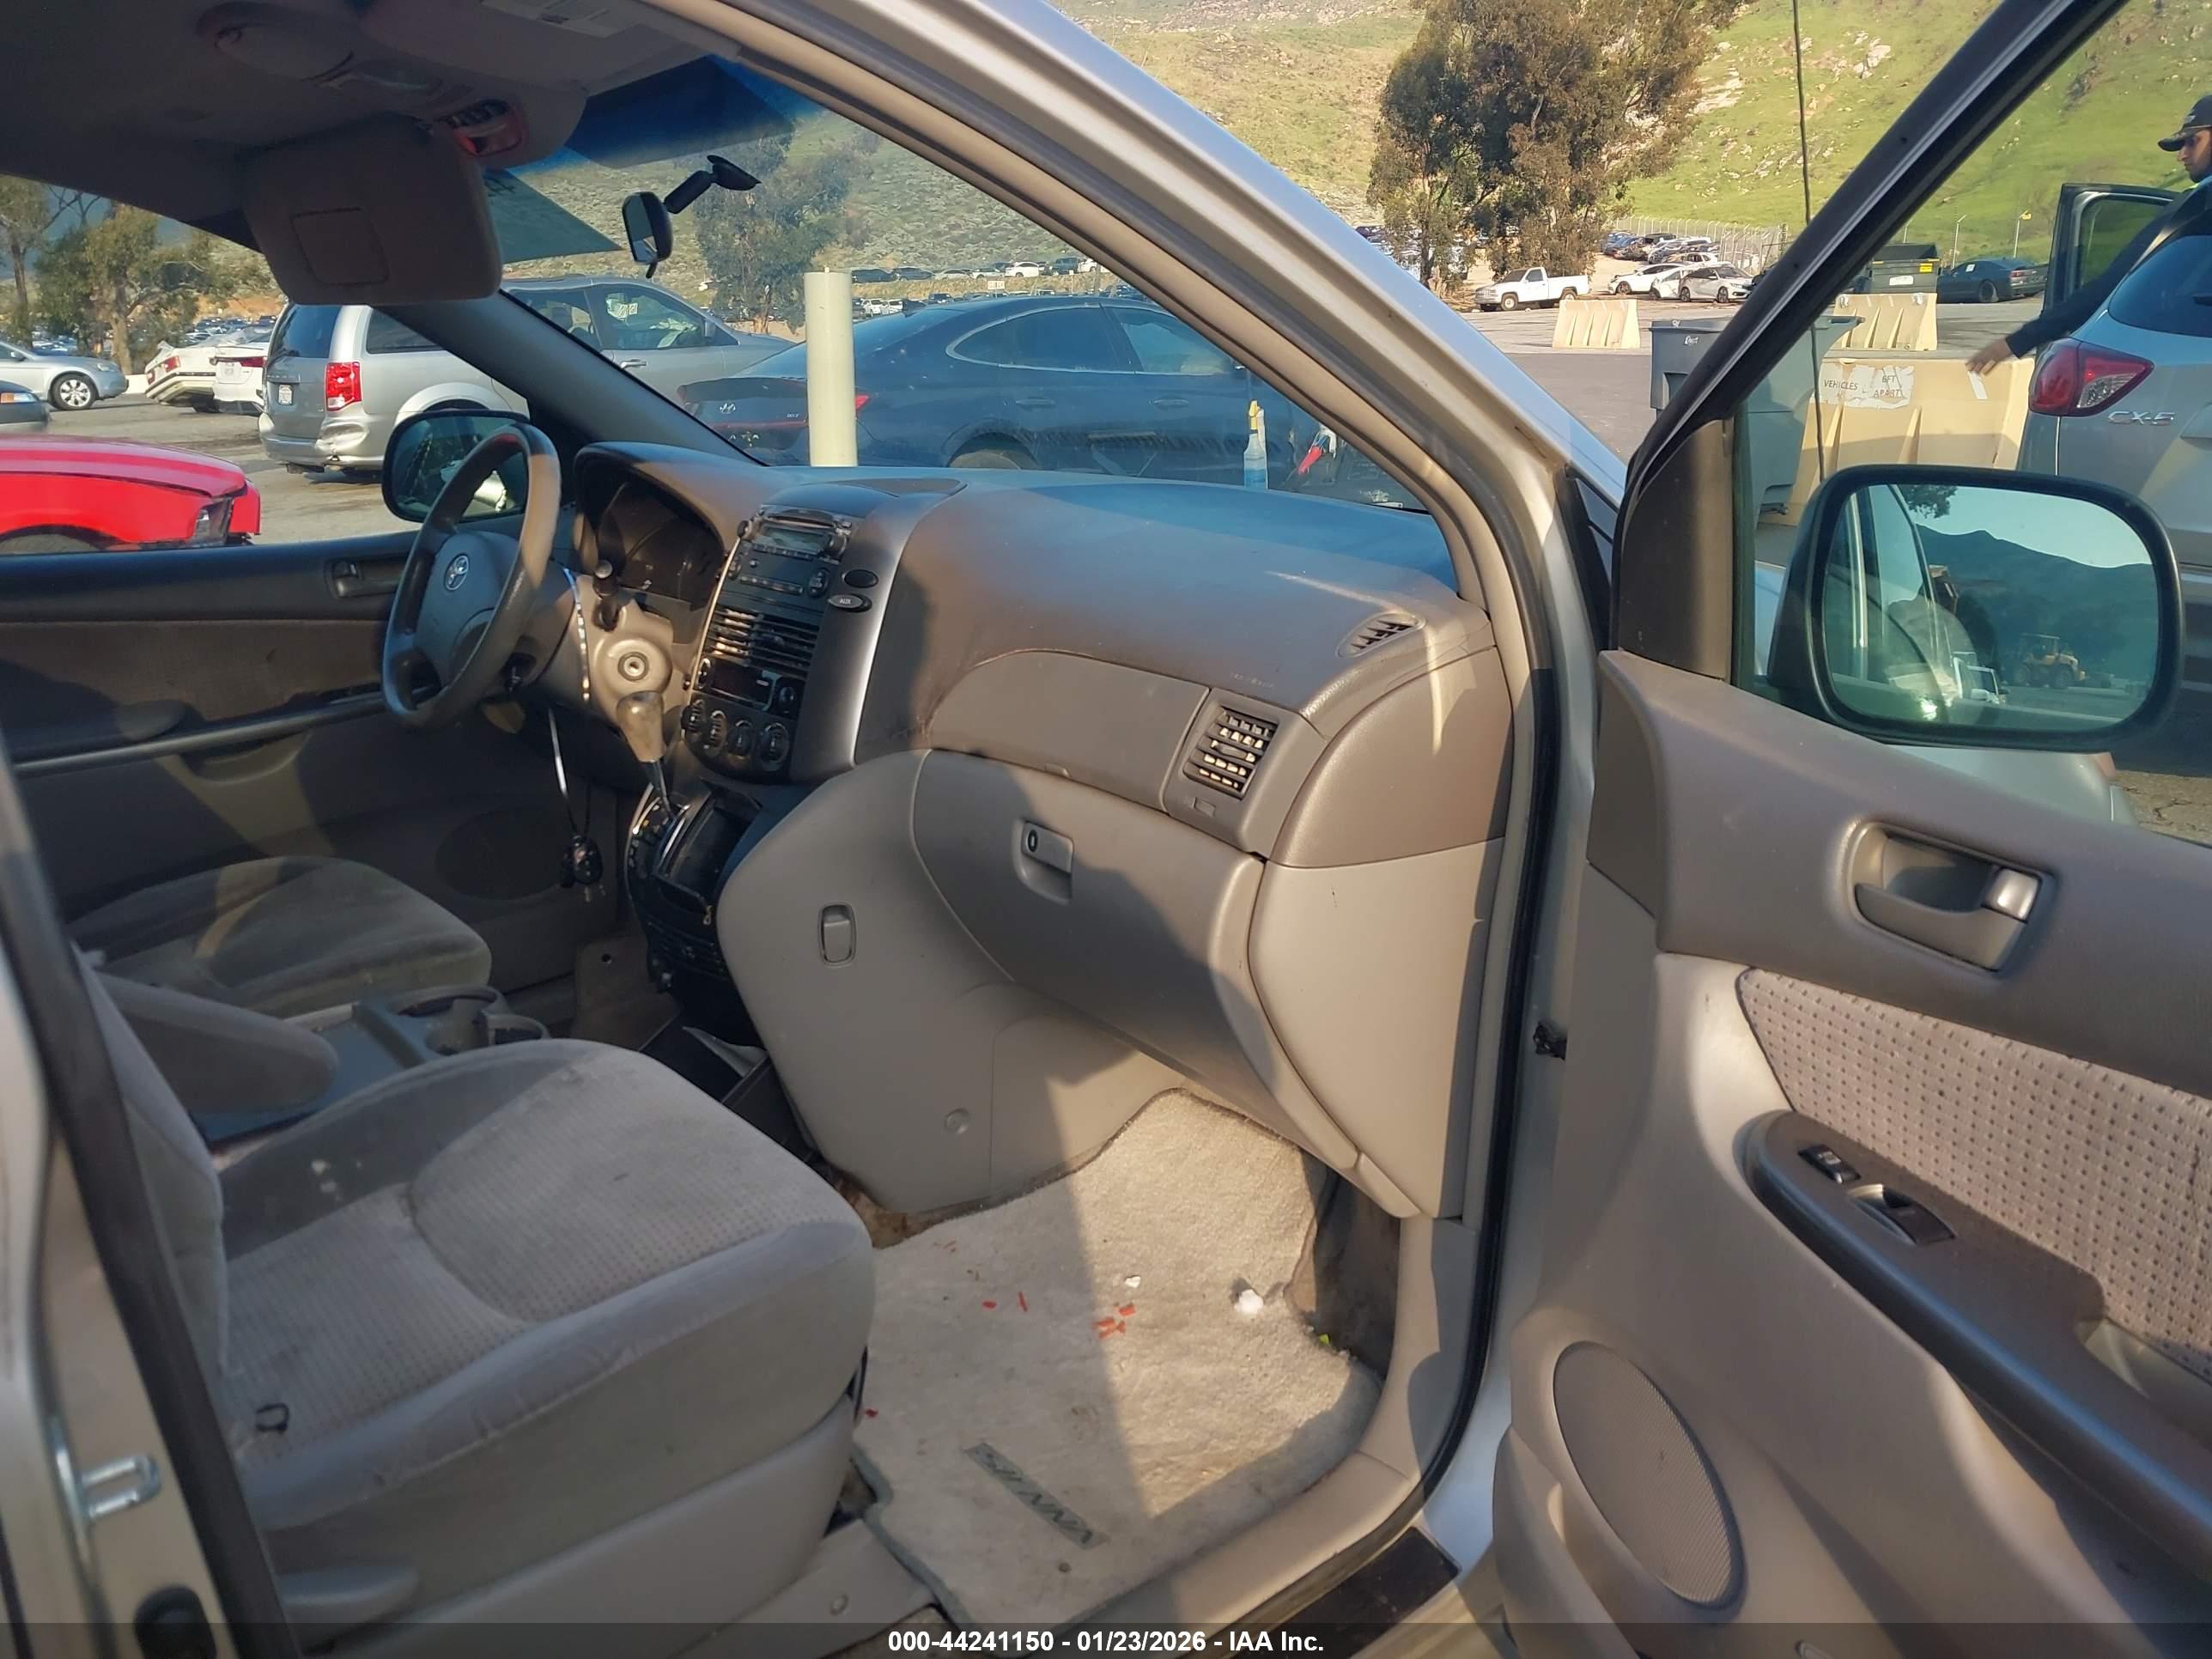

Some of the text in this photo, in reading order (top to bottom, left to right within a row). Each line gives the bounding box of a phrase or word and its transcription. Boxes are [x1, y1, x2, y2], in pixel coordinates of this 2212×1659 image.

[1824, 380, 1858, 391] VEHICLES
[1874, 389, 1900, 398] APART
[2108, 410, 2175, 426] CX-5
